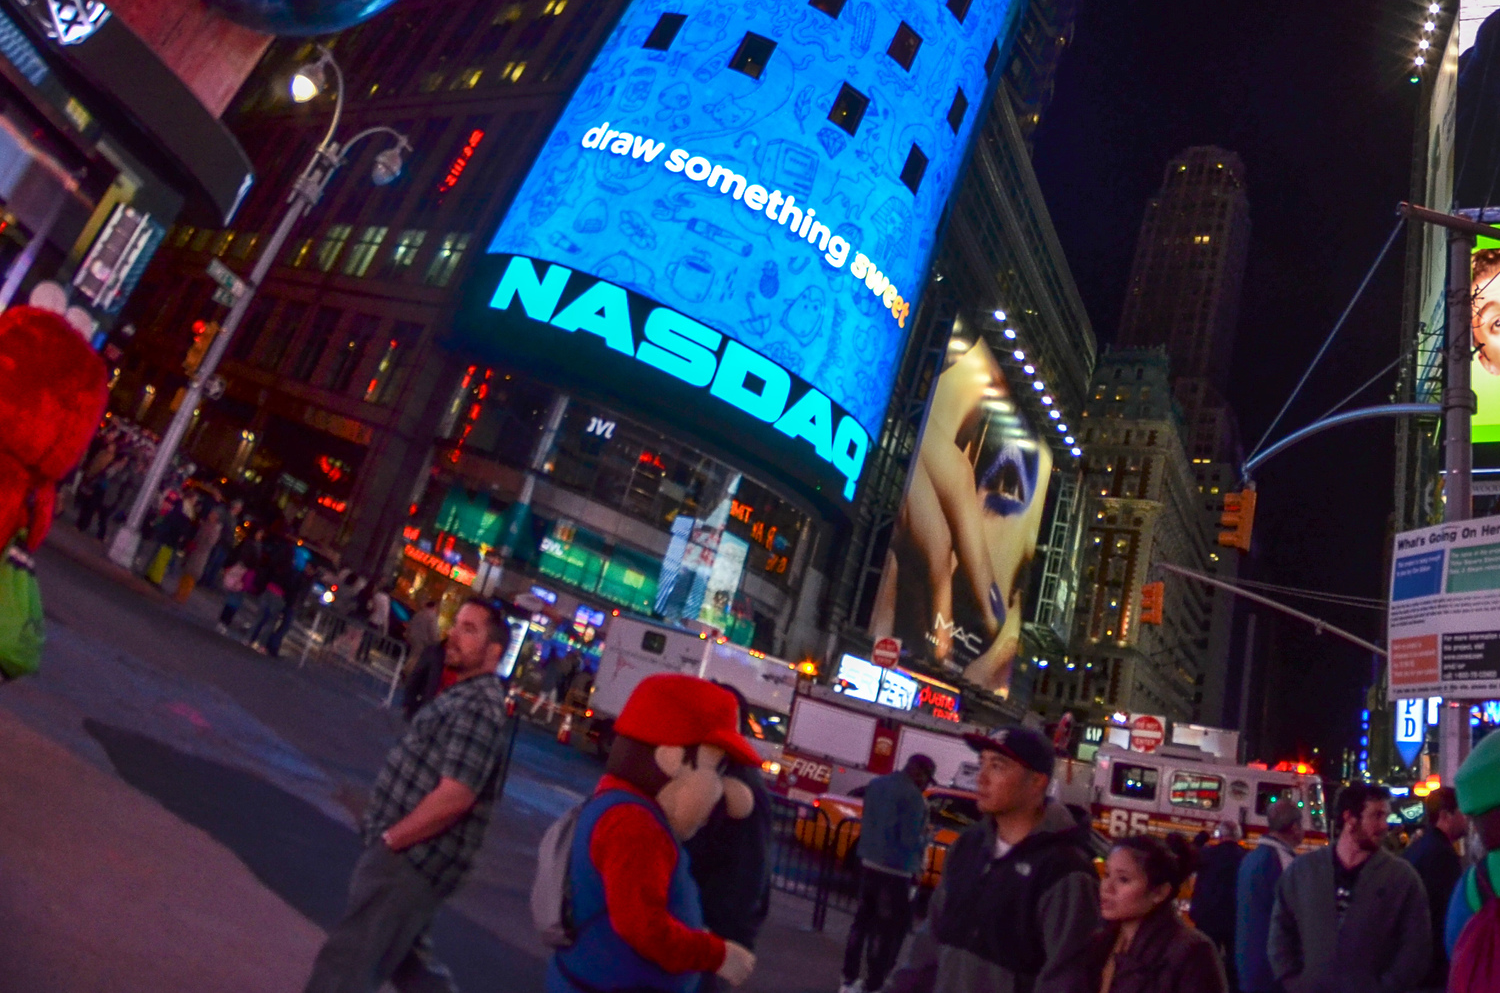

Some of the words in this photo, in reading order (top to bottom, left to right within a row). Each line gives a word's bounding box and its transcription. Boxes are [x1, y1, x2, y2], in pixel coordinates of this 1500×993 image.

[581, 121, 665, 162] draw
[664, 145, 851, 270] something
[850, 250, 910, 329] sweet
[488, 255, 872, 502] NASDAQ
[1397, 536, 1426, 550] What's
[1429, 530, 1457, 544] Going
[1461, 527, 1477, 539] On
[934, 611, 983, 656] MAC
[919, 685, 956, 712] duane
[791, 758, 828, 783] FIRE
[1109, 808, 1149, 838] 65
